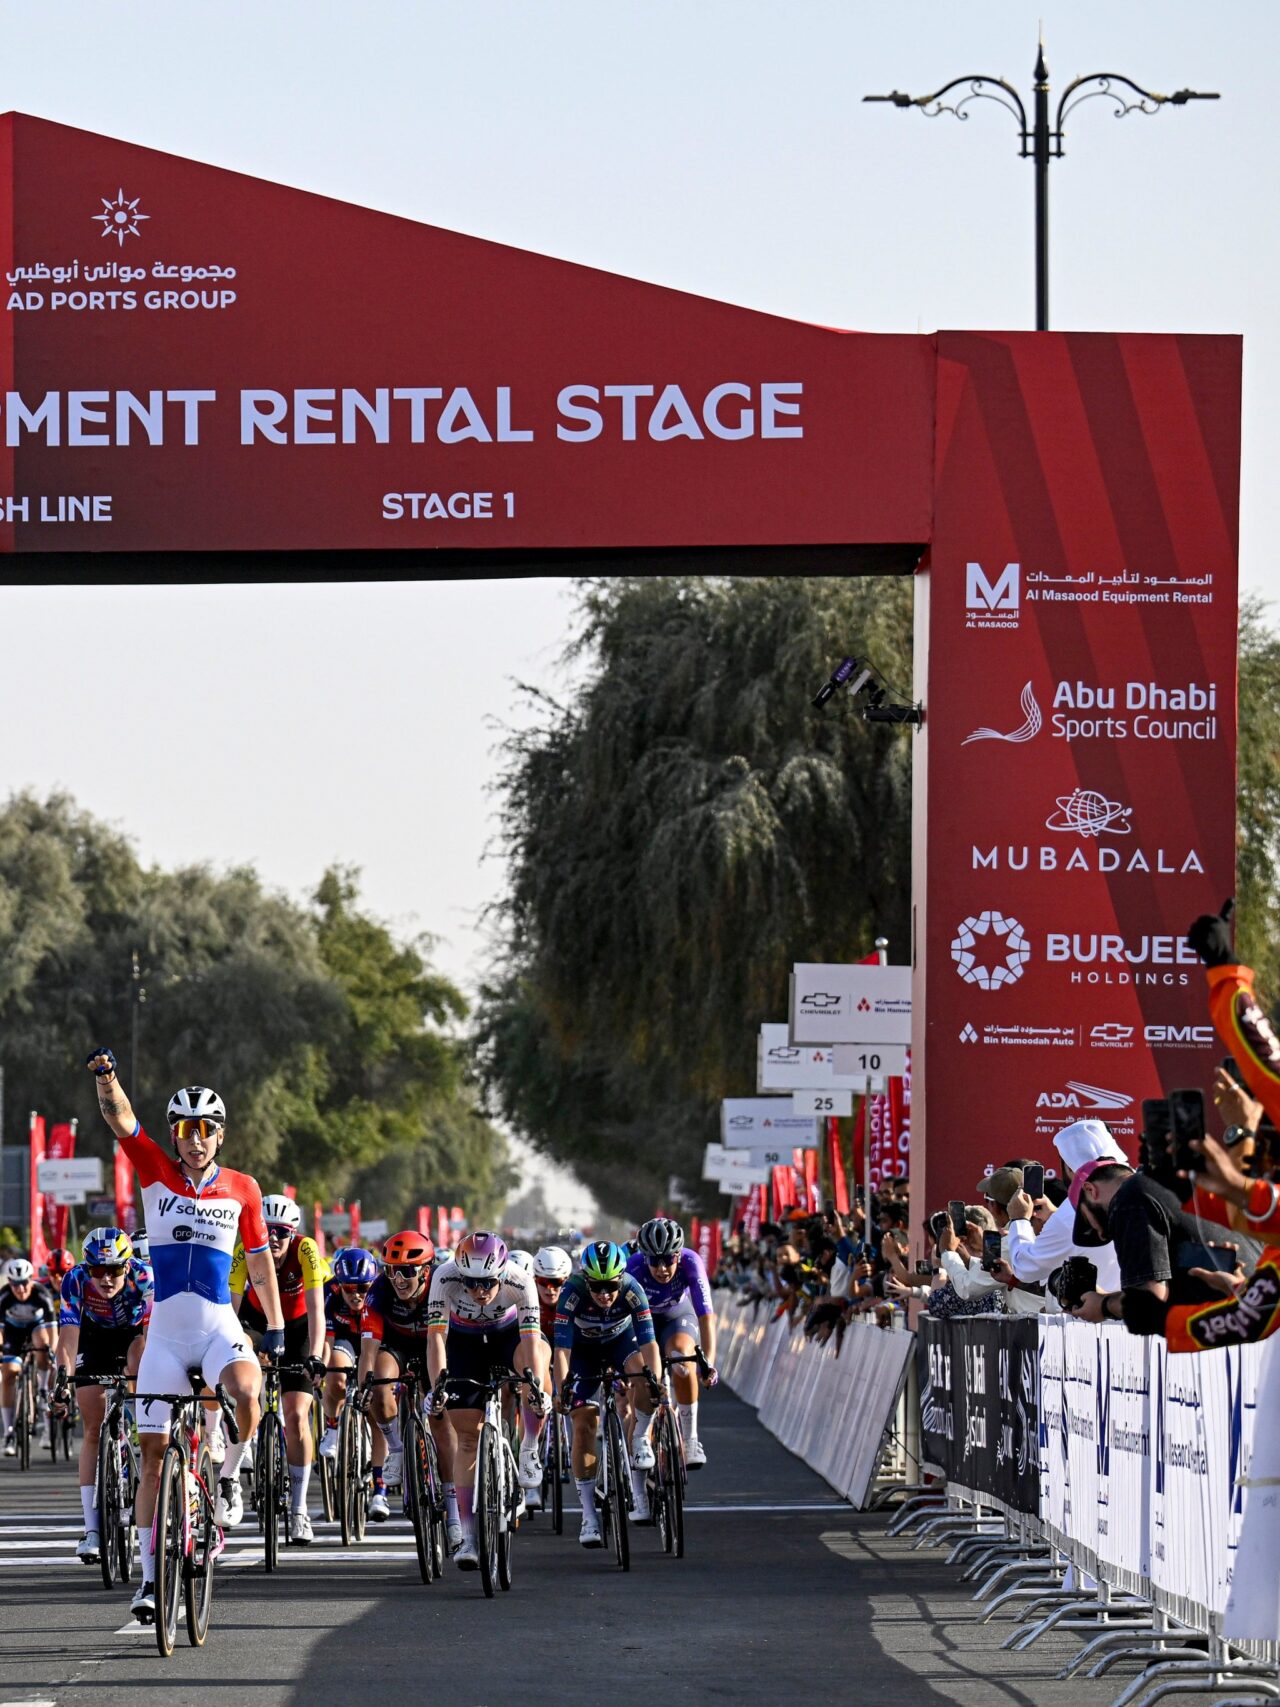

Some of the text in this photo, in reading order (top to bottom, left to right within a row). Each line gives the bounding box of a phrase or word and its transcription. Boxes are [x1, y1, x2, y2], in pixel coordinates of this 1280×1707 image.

[6, 259, 80, 284] أبوظبي
[151, 261, 236, 284] مجموعة
[6, 290, 237, 310] AD PORTS GROUP
[240, 387, 534, 446] RENTAL
[555, 382, 804, 443] STAGE
[40, 495, 113, 522] LINE
[381, 492, 515, 520] STAGE 1
[1025, 589, 1213, 604] Al Masaood Equipment Rental
[1052, 681, 1217, 711] Abu Dhabi
[1051, 713, 1217, 742] Sports Council
[972, 845, 1205, 874] MUBADALA
[1046, 933, 1208, 964] BURJEE
[1070, 971, 1190, 985] HOLDINGS
[983, 1036, 999, 1044] Bin
[1000, 1036, 1050, 1045] Hamoodah
[1143, 1025, 1214, 1042] GMC
[858, 1055, 881, 1070] 10
[814, 1098, 833, 1110] 25
[1035, 1092, 1081, 1108] ADA
[1035, 1126, 1055, 1134] ABU
[765, 1153, 779, 1163] 50
